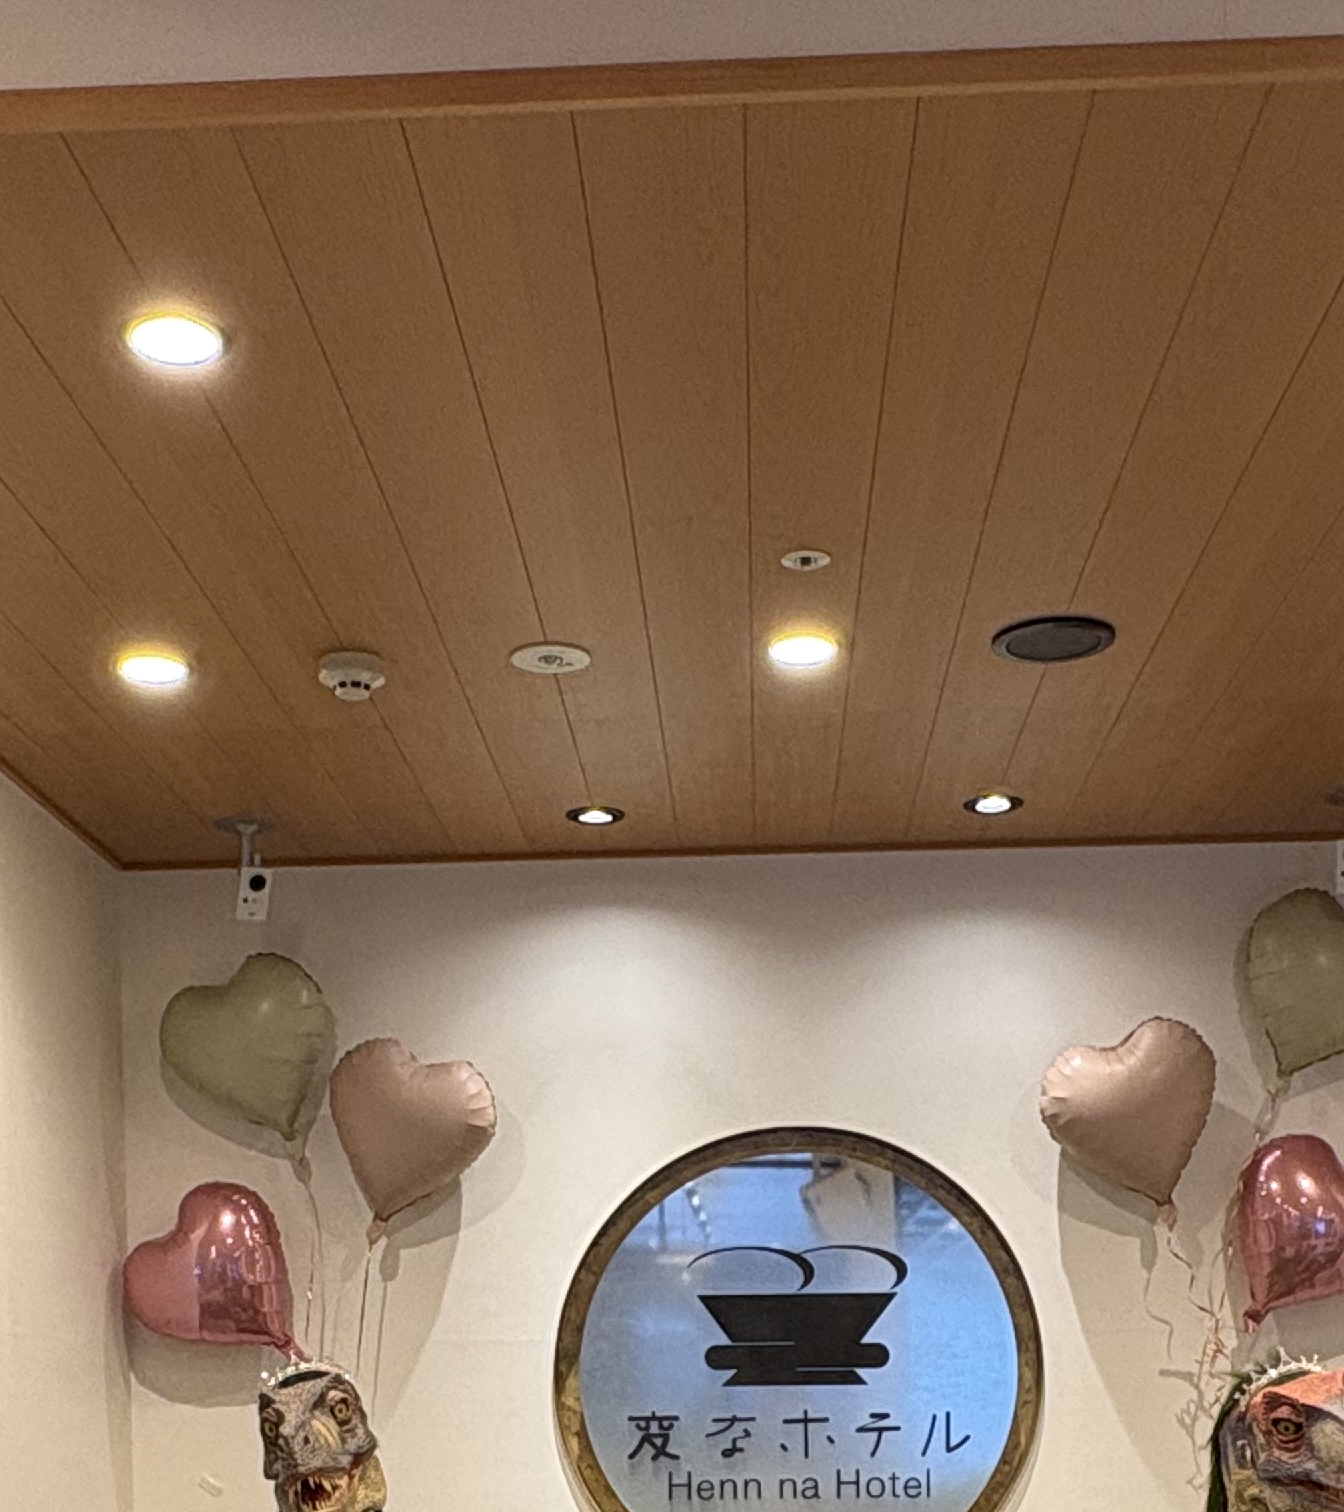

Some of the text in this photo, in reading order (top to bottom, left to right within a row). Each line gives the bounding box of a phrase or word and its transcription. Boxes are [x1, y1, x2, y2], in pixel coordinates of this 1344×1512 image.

[627, 1409, 972, 1461] 変なホテル
[668, 1468, 933, 1501] Henn na Hotel
